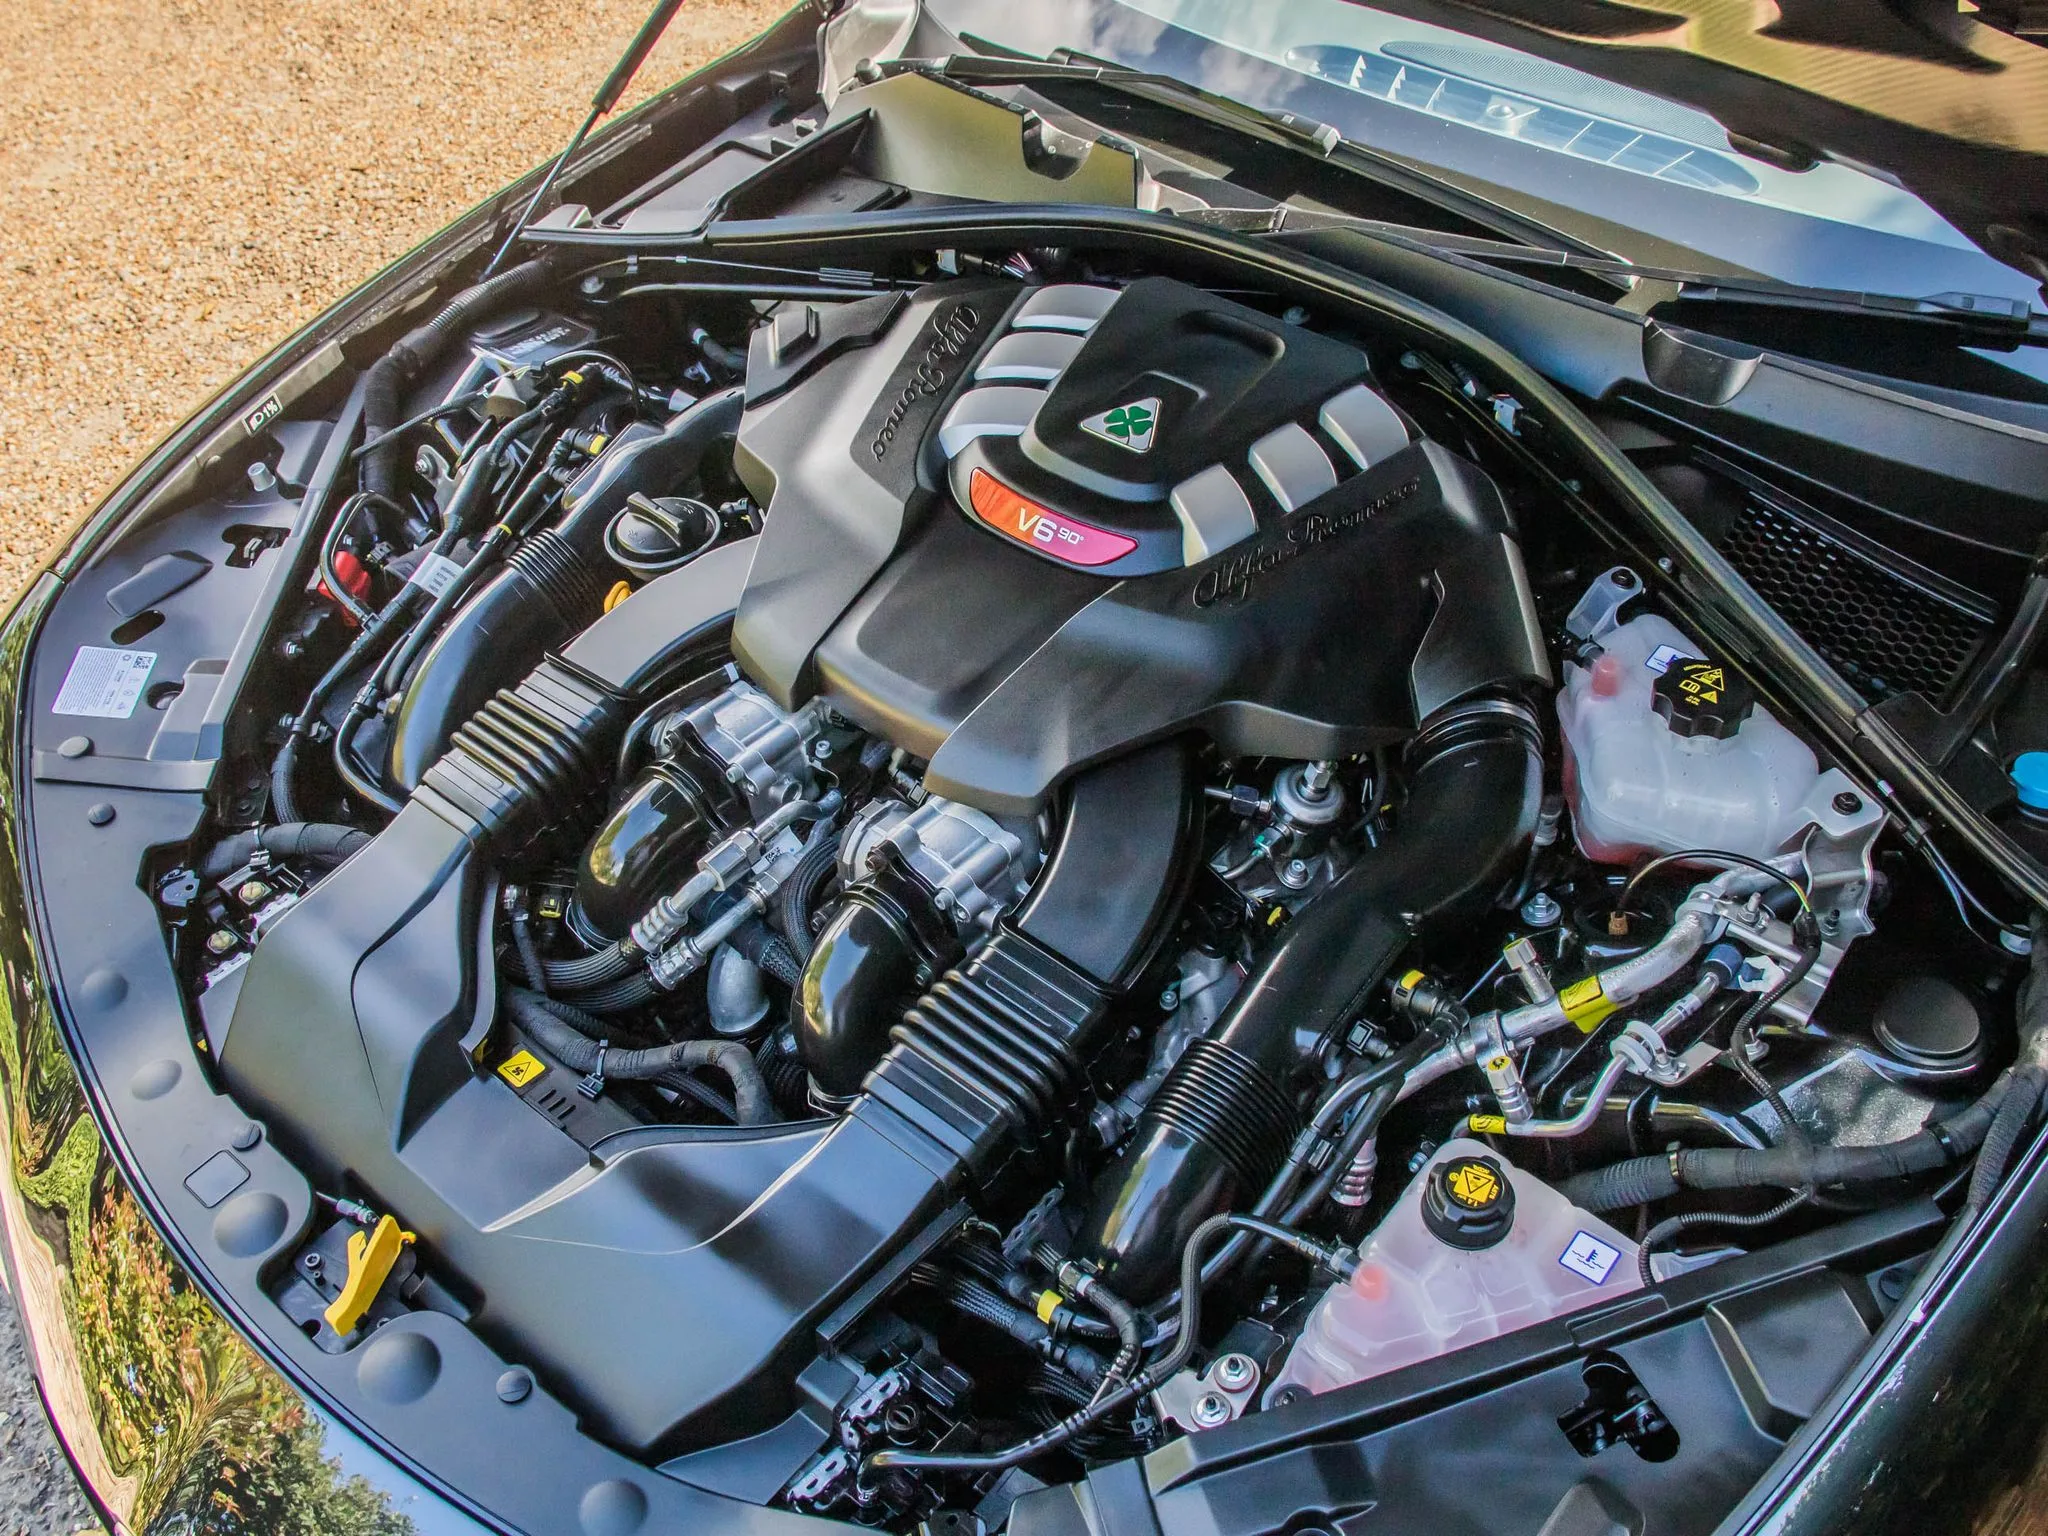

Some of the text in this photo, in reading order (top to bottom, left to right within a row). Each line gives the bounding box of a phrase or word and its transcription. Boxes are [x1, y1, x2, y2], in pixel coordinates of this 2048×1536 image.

[870, 305, 980, 463] Alfa Romeo
[1018, 507, 1057, 544] V6
[1192, 477, 1421, 608] Alfa Romeo
